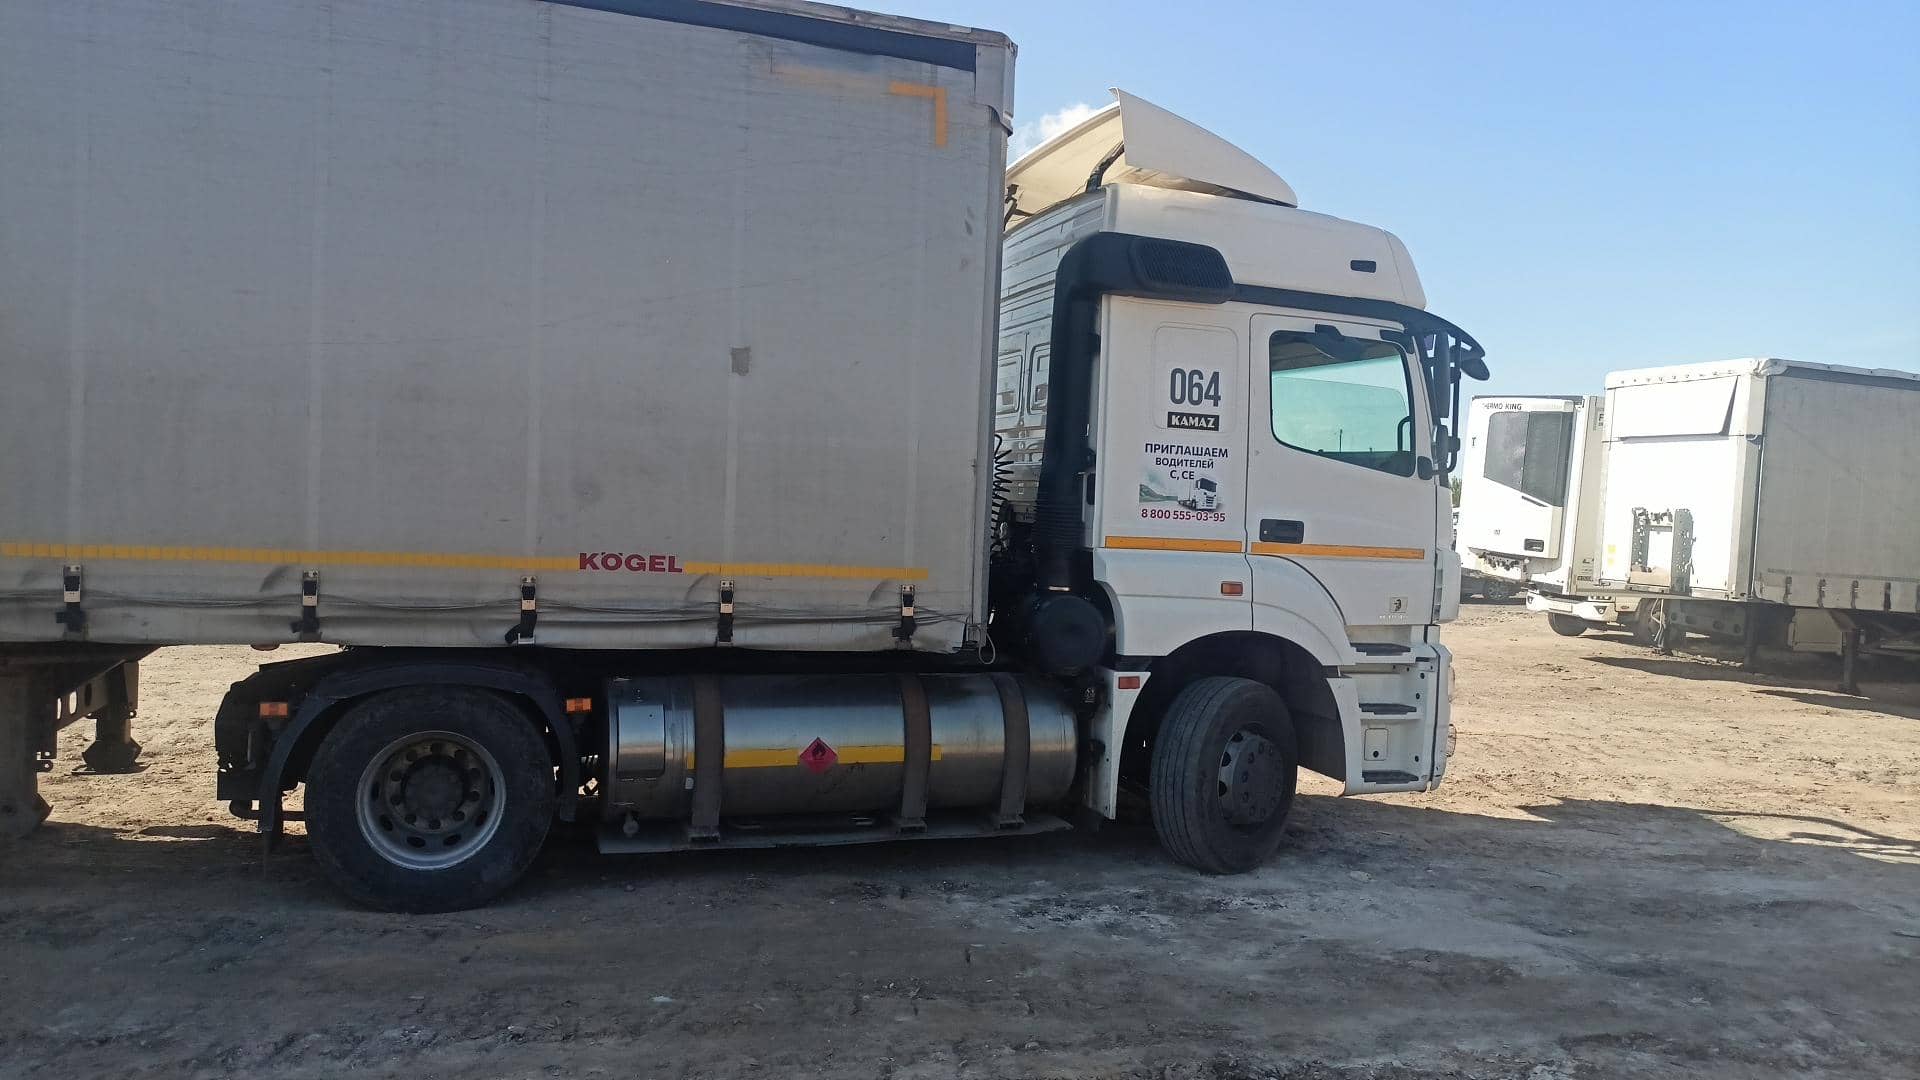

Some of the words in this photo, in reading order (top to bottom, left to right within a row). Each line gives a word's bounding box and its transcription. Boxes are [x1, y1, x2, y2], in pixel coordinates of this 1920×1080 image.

[1170, 368, 1221, 407] 064
[1505, 403, 1521, 411] KING
[1171, 415, 1215, 428] KAMAZ
[1145, 443, 1228, 458] ПРИГЛАШАЕМ
[1155, 457, 1214, 469] ВОДИТЕЛЕЙ
[1141, 508, 1148, 518] 8
[1150, 509, 1171, 519] 800
[1172, 510, 1226, 522] 555-03-95
[579, 552, 683, 573] KÖGEL
